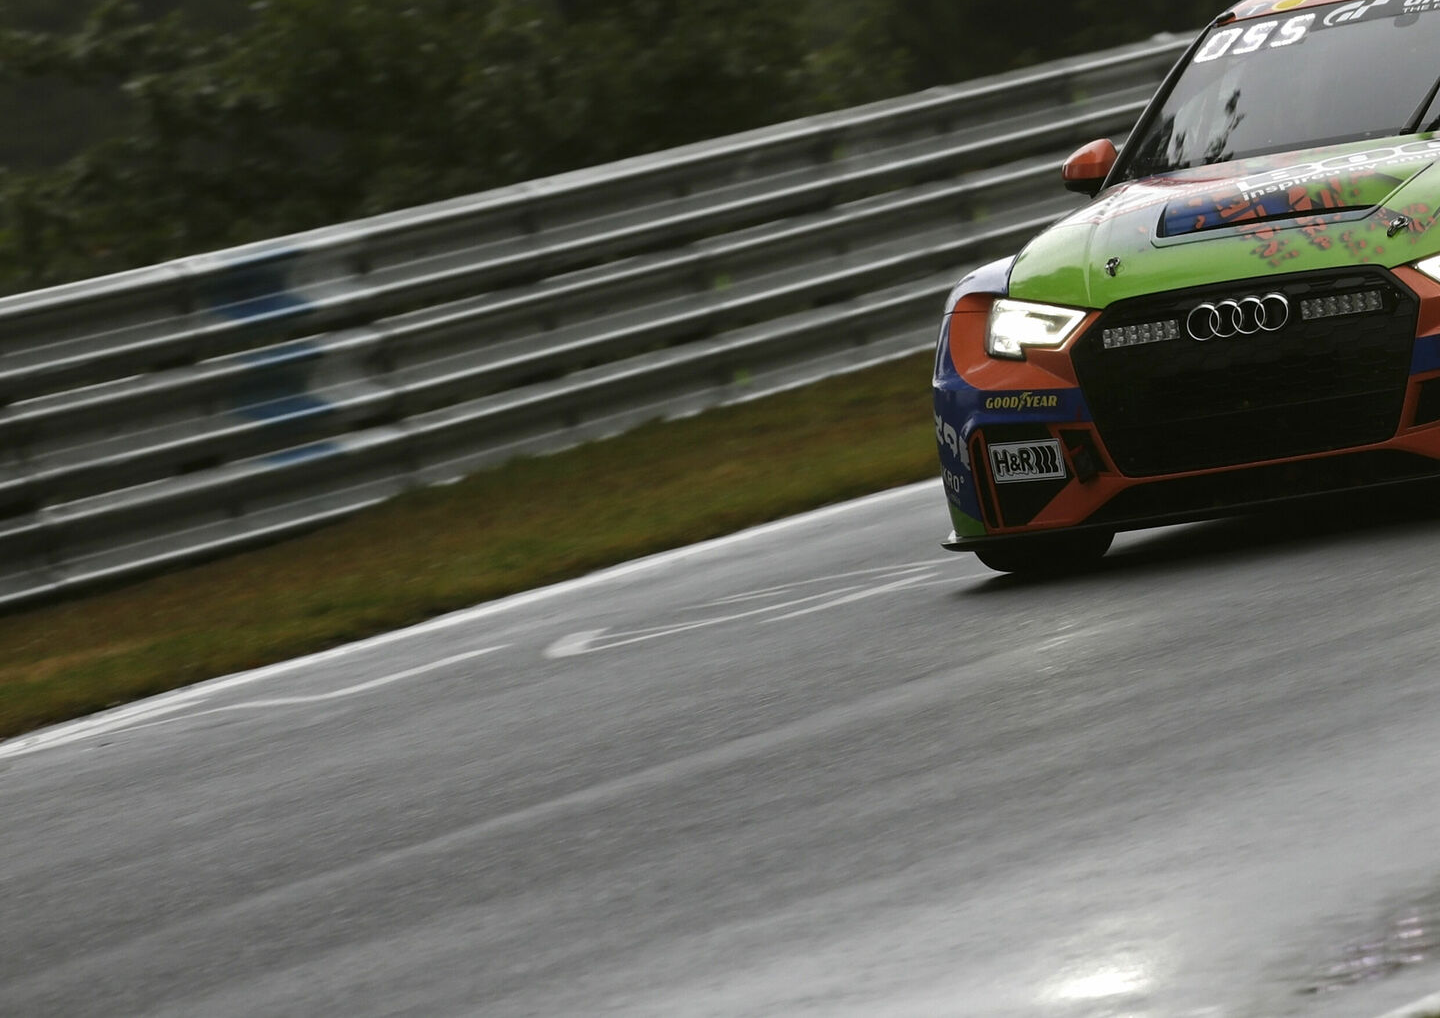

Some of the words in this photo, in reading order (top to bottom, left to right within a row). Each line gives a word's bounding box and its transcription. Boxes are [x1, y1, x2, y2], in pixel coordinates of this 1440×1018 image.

[1402, 3, 1426, 14] THE
[985, 392, 1058, 410] GOODYEAR
[992, 448, 1034, 476] H&R
